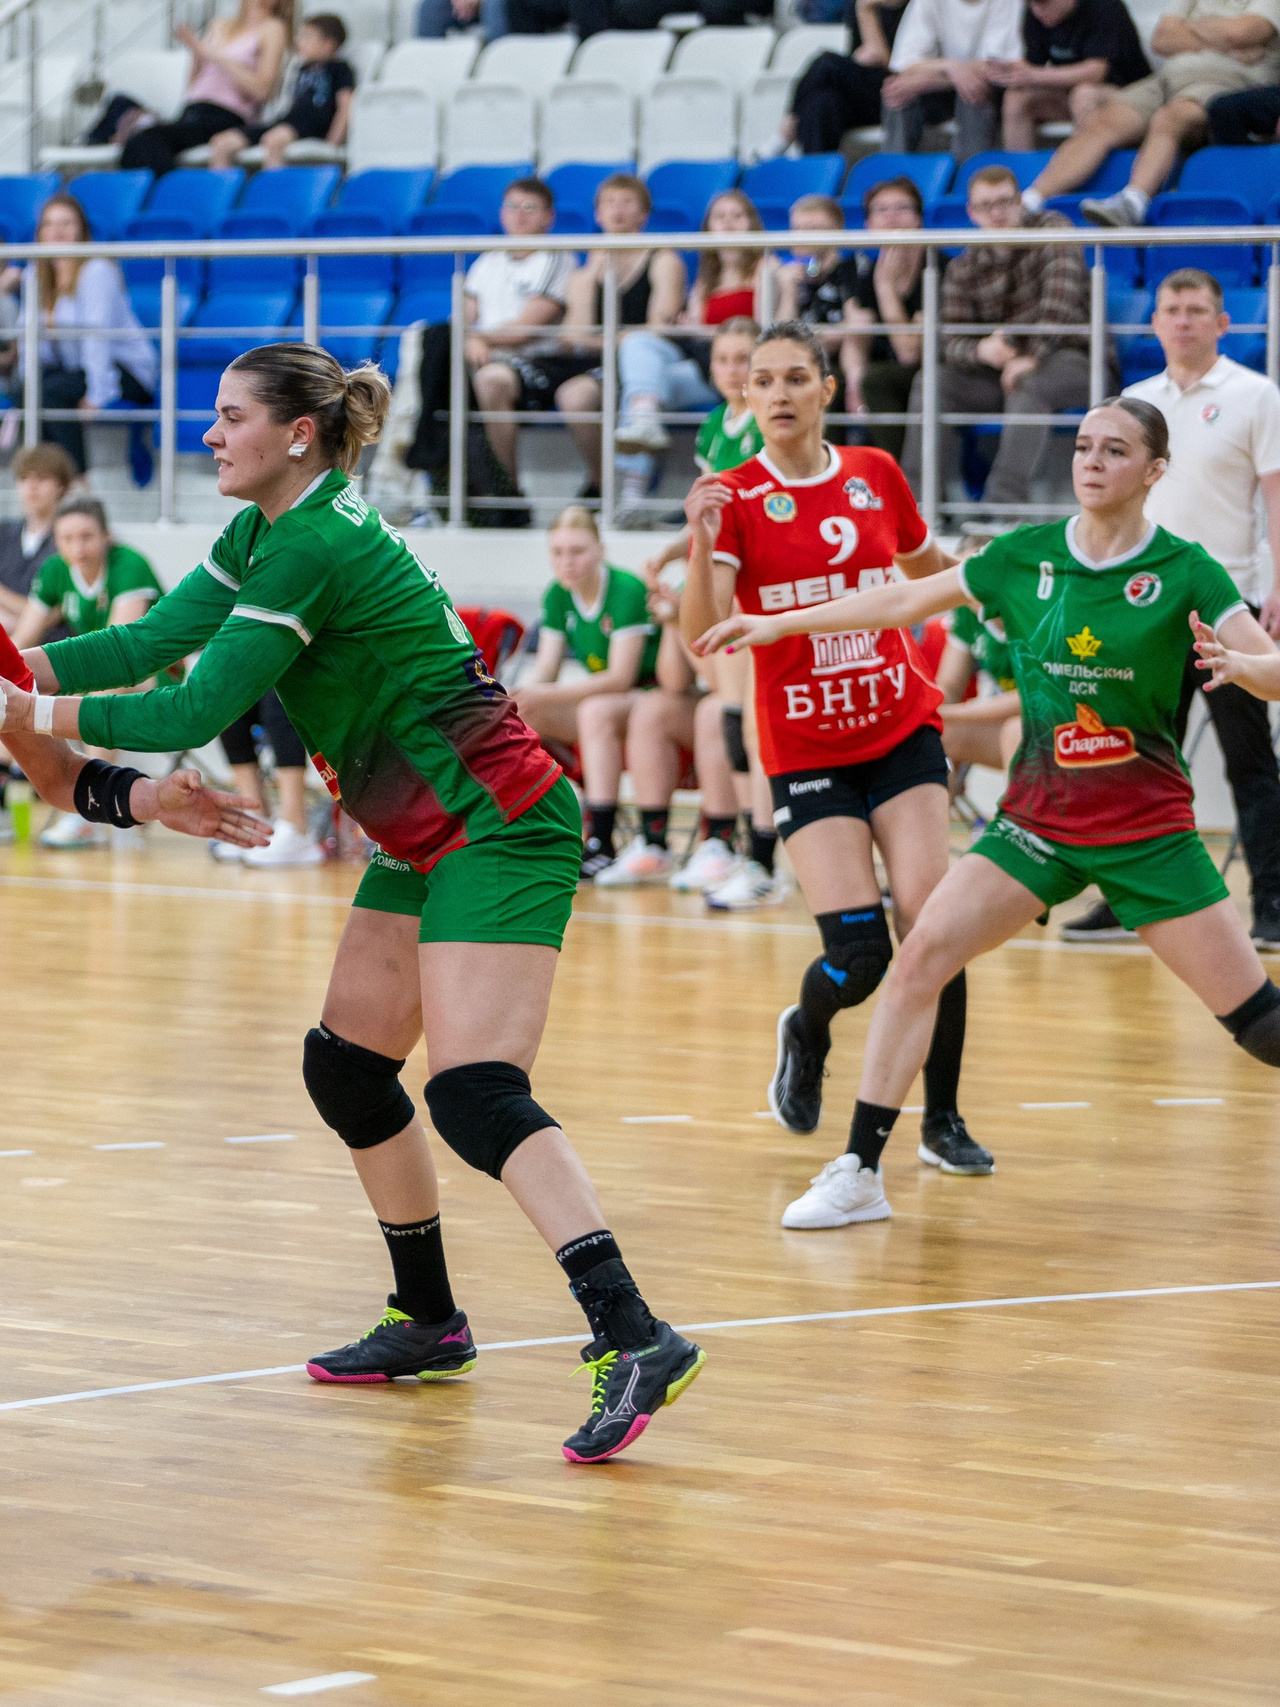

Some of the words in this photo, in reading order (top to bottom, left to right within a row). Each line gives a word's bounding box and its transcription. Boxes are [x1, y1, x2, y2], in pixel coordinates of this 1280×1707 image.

[819, 516, 858, 565] 9
[1037, 561, 1055, 600] 6
[1042, 661, 1135, 681] ОМЕЛЬСКИЙ
[783, 662, 907, 720] БНТУ
[837, 712, 878, 730] 1920
[789, 777, 833, 796] Kempa
[382, 1219, 439, 1237] Kempa
[557, 1233, 613, 1262] Kempa
